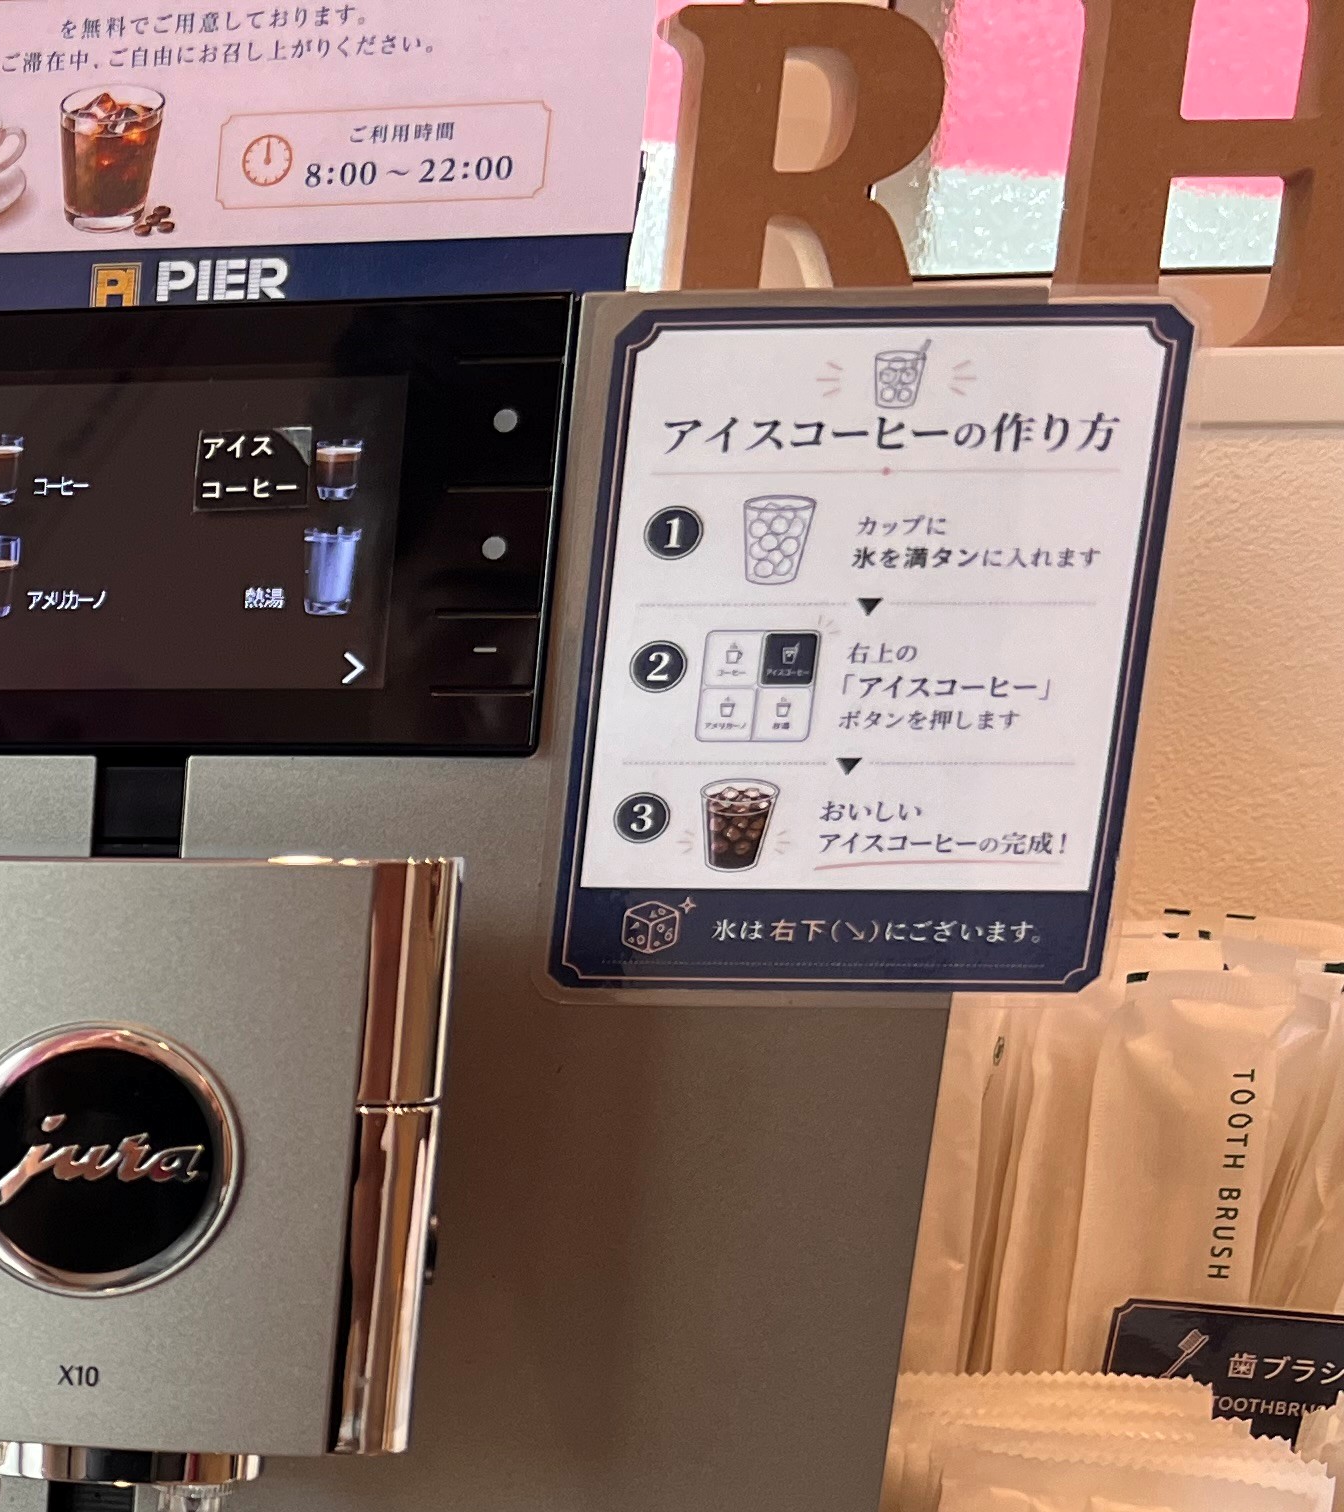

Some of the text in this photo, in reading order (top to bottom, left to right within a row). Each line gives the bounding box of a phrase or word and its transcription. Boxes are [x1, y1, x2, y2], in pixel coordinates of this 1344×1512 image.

[349, 121, 455, 144] ご利用時間
[156, 258, 288, 302] PIER
[663, 411, 1121, 456] アイスコーヒーの作り方
[202, 436, 274, 459] アイス
[33, 476, 90, 497] コーヒー
[201, 478, 299, 499] コーヒー
[858, 515, 949, 540] カップに
[851, 545, 1102, 571] 氷を満タンに入れます
[26, 590, 107, 610] アメリカーノ
[244, 587, 285, 609] 熱湯
[847, 642, 918, 666] 右上の
[840, 674, 1057, 702] 「アイスコーヒー」
[837, 708, 1021, 733] ボタンを押します
[818, 799, 923, 824] おいしい
[1206, 1068, 1256, 1281] TOOTH BRUSH
[57, 1364, 100, 1387] X10
